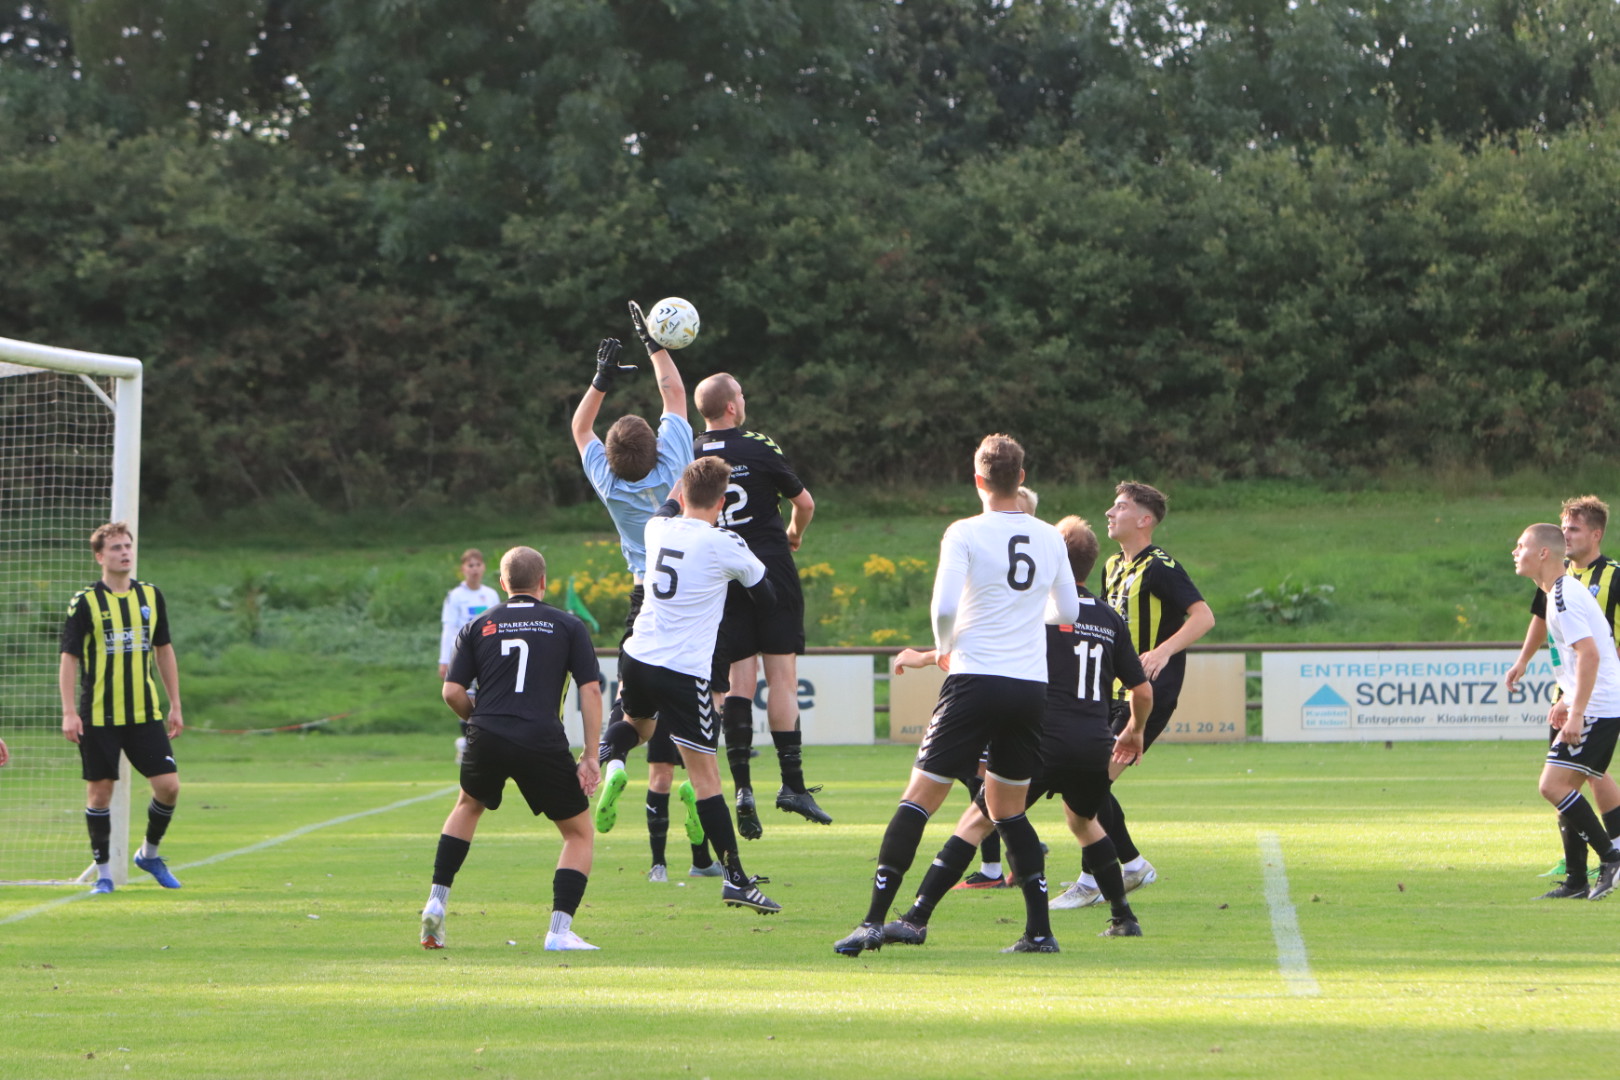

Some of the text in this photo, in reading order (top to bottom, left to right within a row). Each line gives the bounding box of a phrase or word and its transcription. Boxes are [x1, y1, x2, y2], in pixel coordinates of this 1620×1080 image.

[652, 547, 685, 600] 5
[1007, 534, 1036, 591] 6
[498, 621, 554, 629] SPAREKASSEN
[501, 638, 529, 693] 7
[1073, 640, 1104, 701] 11
[1356, 681, 1498, 706] SCHANTZ
[1175, 722, 1191, 733] 21
[1197, 722, 1214, 733] 20
[1219, 722, 1235, 733] 24
[1437, 713, 1510, 724] Kloakmester
